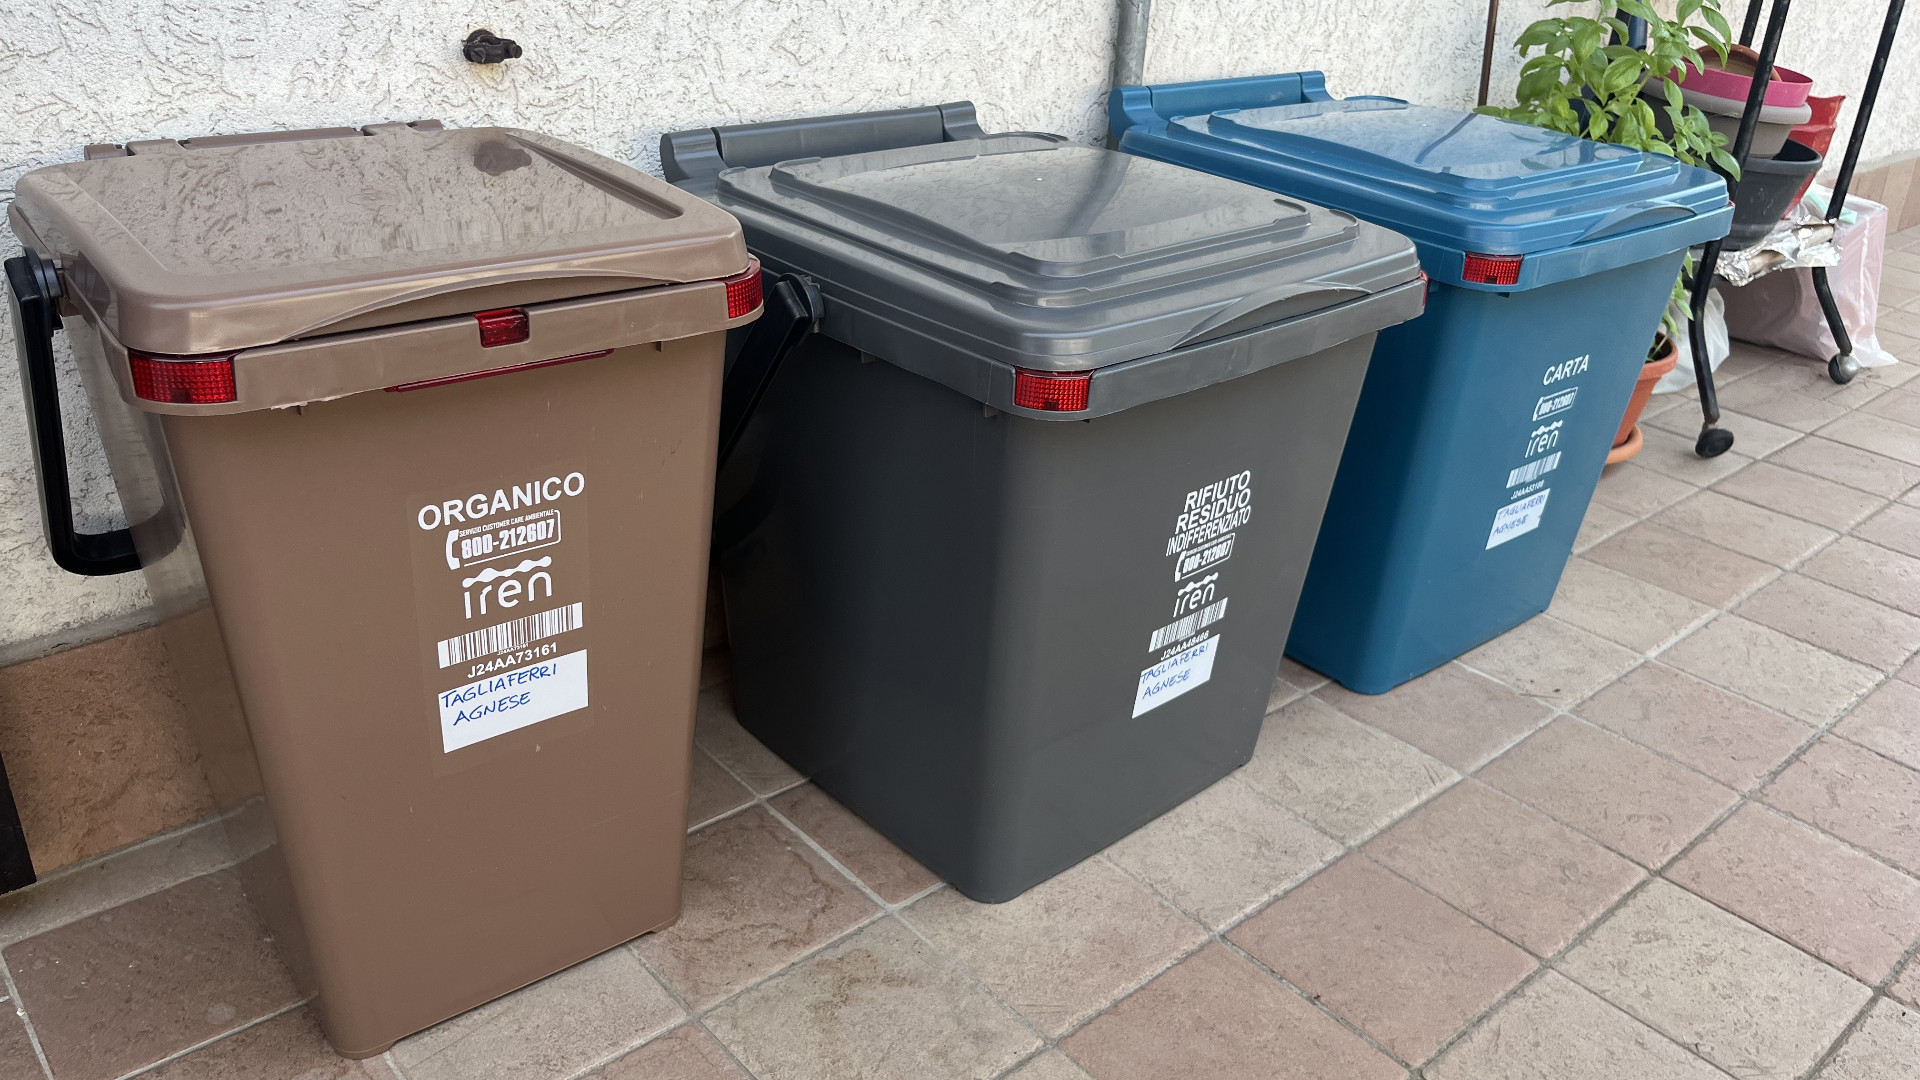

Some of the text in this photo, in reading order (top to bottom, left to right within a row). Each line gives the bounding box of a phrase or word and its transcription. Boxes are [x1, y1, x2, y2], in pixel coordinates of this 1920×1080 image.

[1543, 354, 1590, 386] CARTA
[1524, 430, 1559, 458] iren
[418, 472, 585, 530] ORGANICO
[1184, 470, 1251, 513] RIFIUTO
[1498, 494, 1546, 521] TAGLIAFERRI
[459, 509, 555, 537] SERVIZIO CUSTOMER CARE AMBIENTALE
[1175, 488, 1251, 534] RESIDUO
[1493, 514, 1529, 537] AGNESE
[461, 518, 555, 559] 800-212607
[1165, 505, 1251, 557] INDIFFERENZIATO
[464, 571, 552, 619] iren
[1173, 583, 1215, 618] iren
[467, 642, 557, 678] J24AA73161
[1140, 642, 1209, 685] TAGLIAFERRI
[441, 663, 557, 708] TAGLIAFERRI
[1142, 669, 1191, 700] AGNESE
[453, 692, 531, 726] AGNESE
